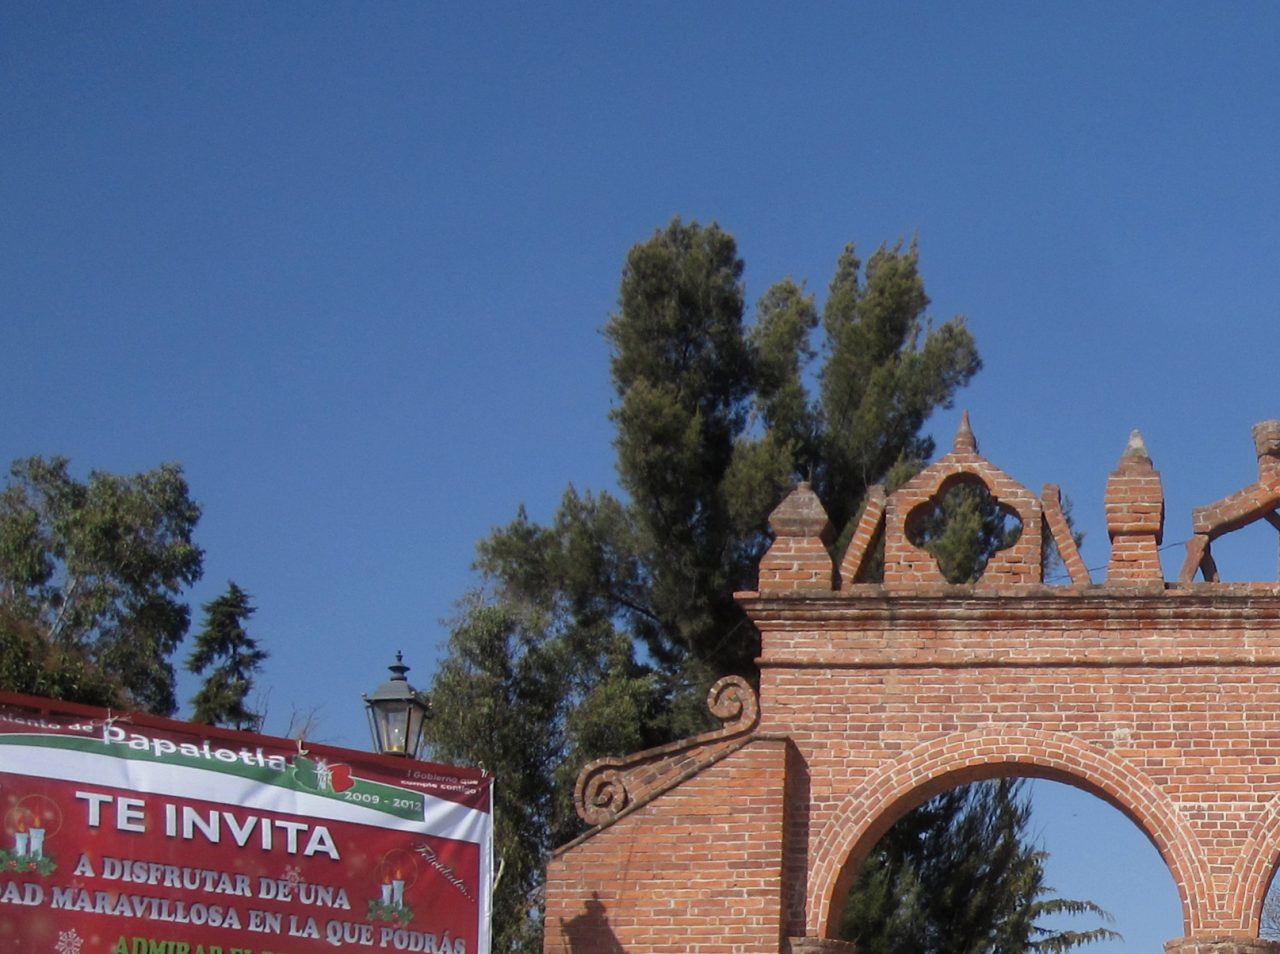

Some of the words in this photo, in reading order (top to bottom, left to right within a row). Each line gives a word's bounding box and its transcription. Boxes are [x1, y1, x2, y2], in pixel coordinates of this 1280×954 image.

[68, 723, 94, 733] de
[401, 780, 438, 788] cumple
[413, 771, 458, 783] Gobierno
[344, 791, 380, 804] 2009
[392, 798, 422, 811] 2012
[75, 791, 146, 833] TE
[165, 803, 341, 860] INVITA
[73, 853, 96, 878] A
[102, 856, 253, 898] DISFRUTAR
[258, 877, 293, 902] DE
[302, 882, 352, 910] UNA
[0, 880, 44, 906] AD
[51, 886, 242, 930] MARAVILLOSA
[248, 910, 282, 935] EN
[288, 915, 321, 940] LA
[325, 920, 374, 947] QUE
